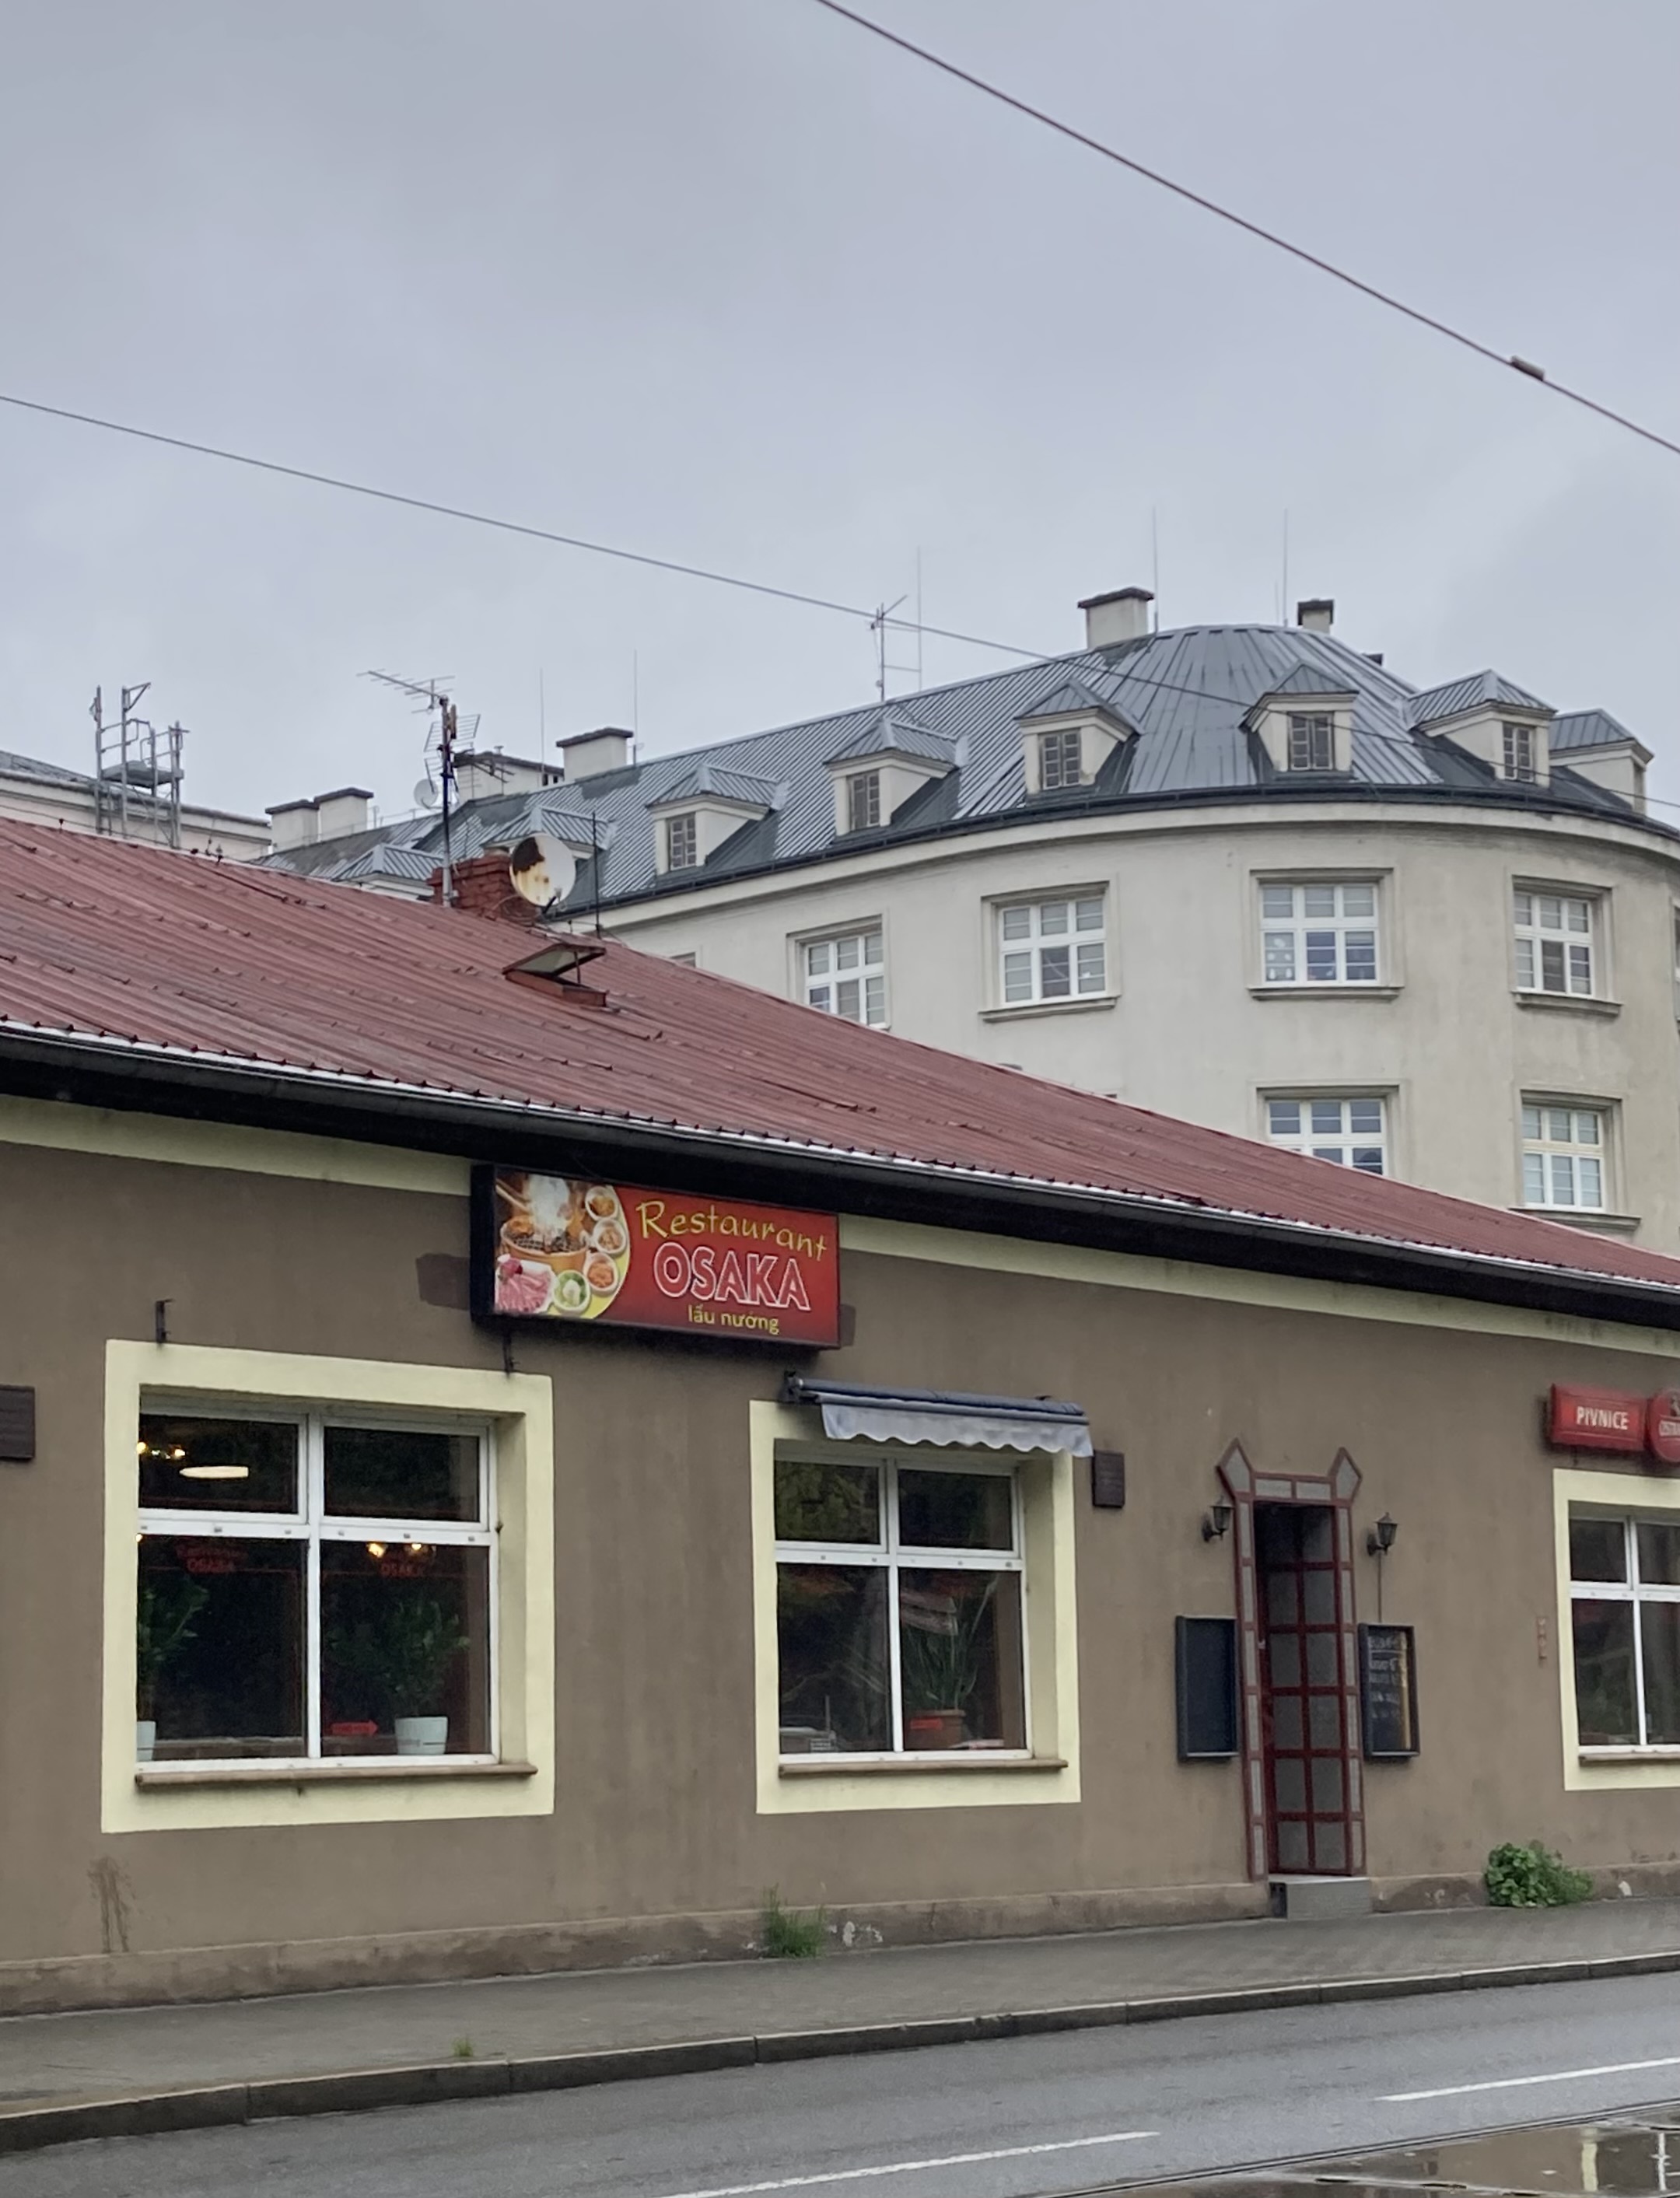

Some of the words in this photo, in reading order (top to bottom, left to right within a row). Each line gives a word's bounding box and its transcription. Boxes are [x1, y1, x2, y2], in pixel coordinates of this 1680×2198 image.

[635, 1200, 828, 1261] Restaurant
[653, 1241, 810, 1311] OSAKA
[1577, 1405, 1629, 1430] PIVNICE
